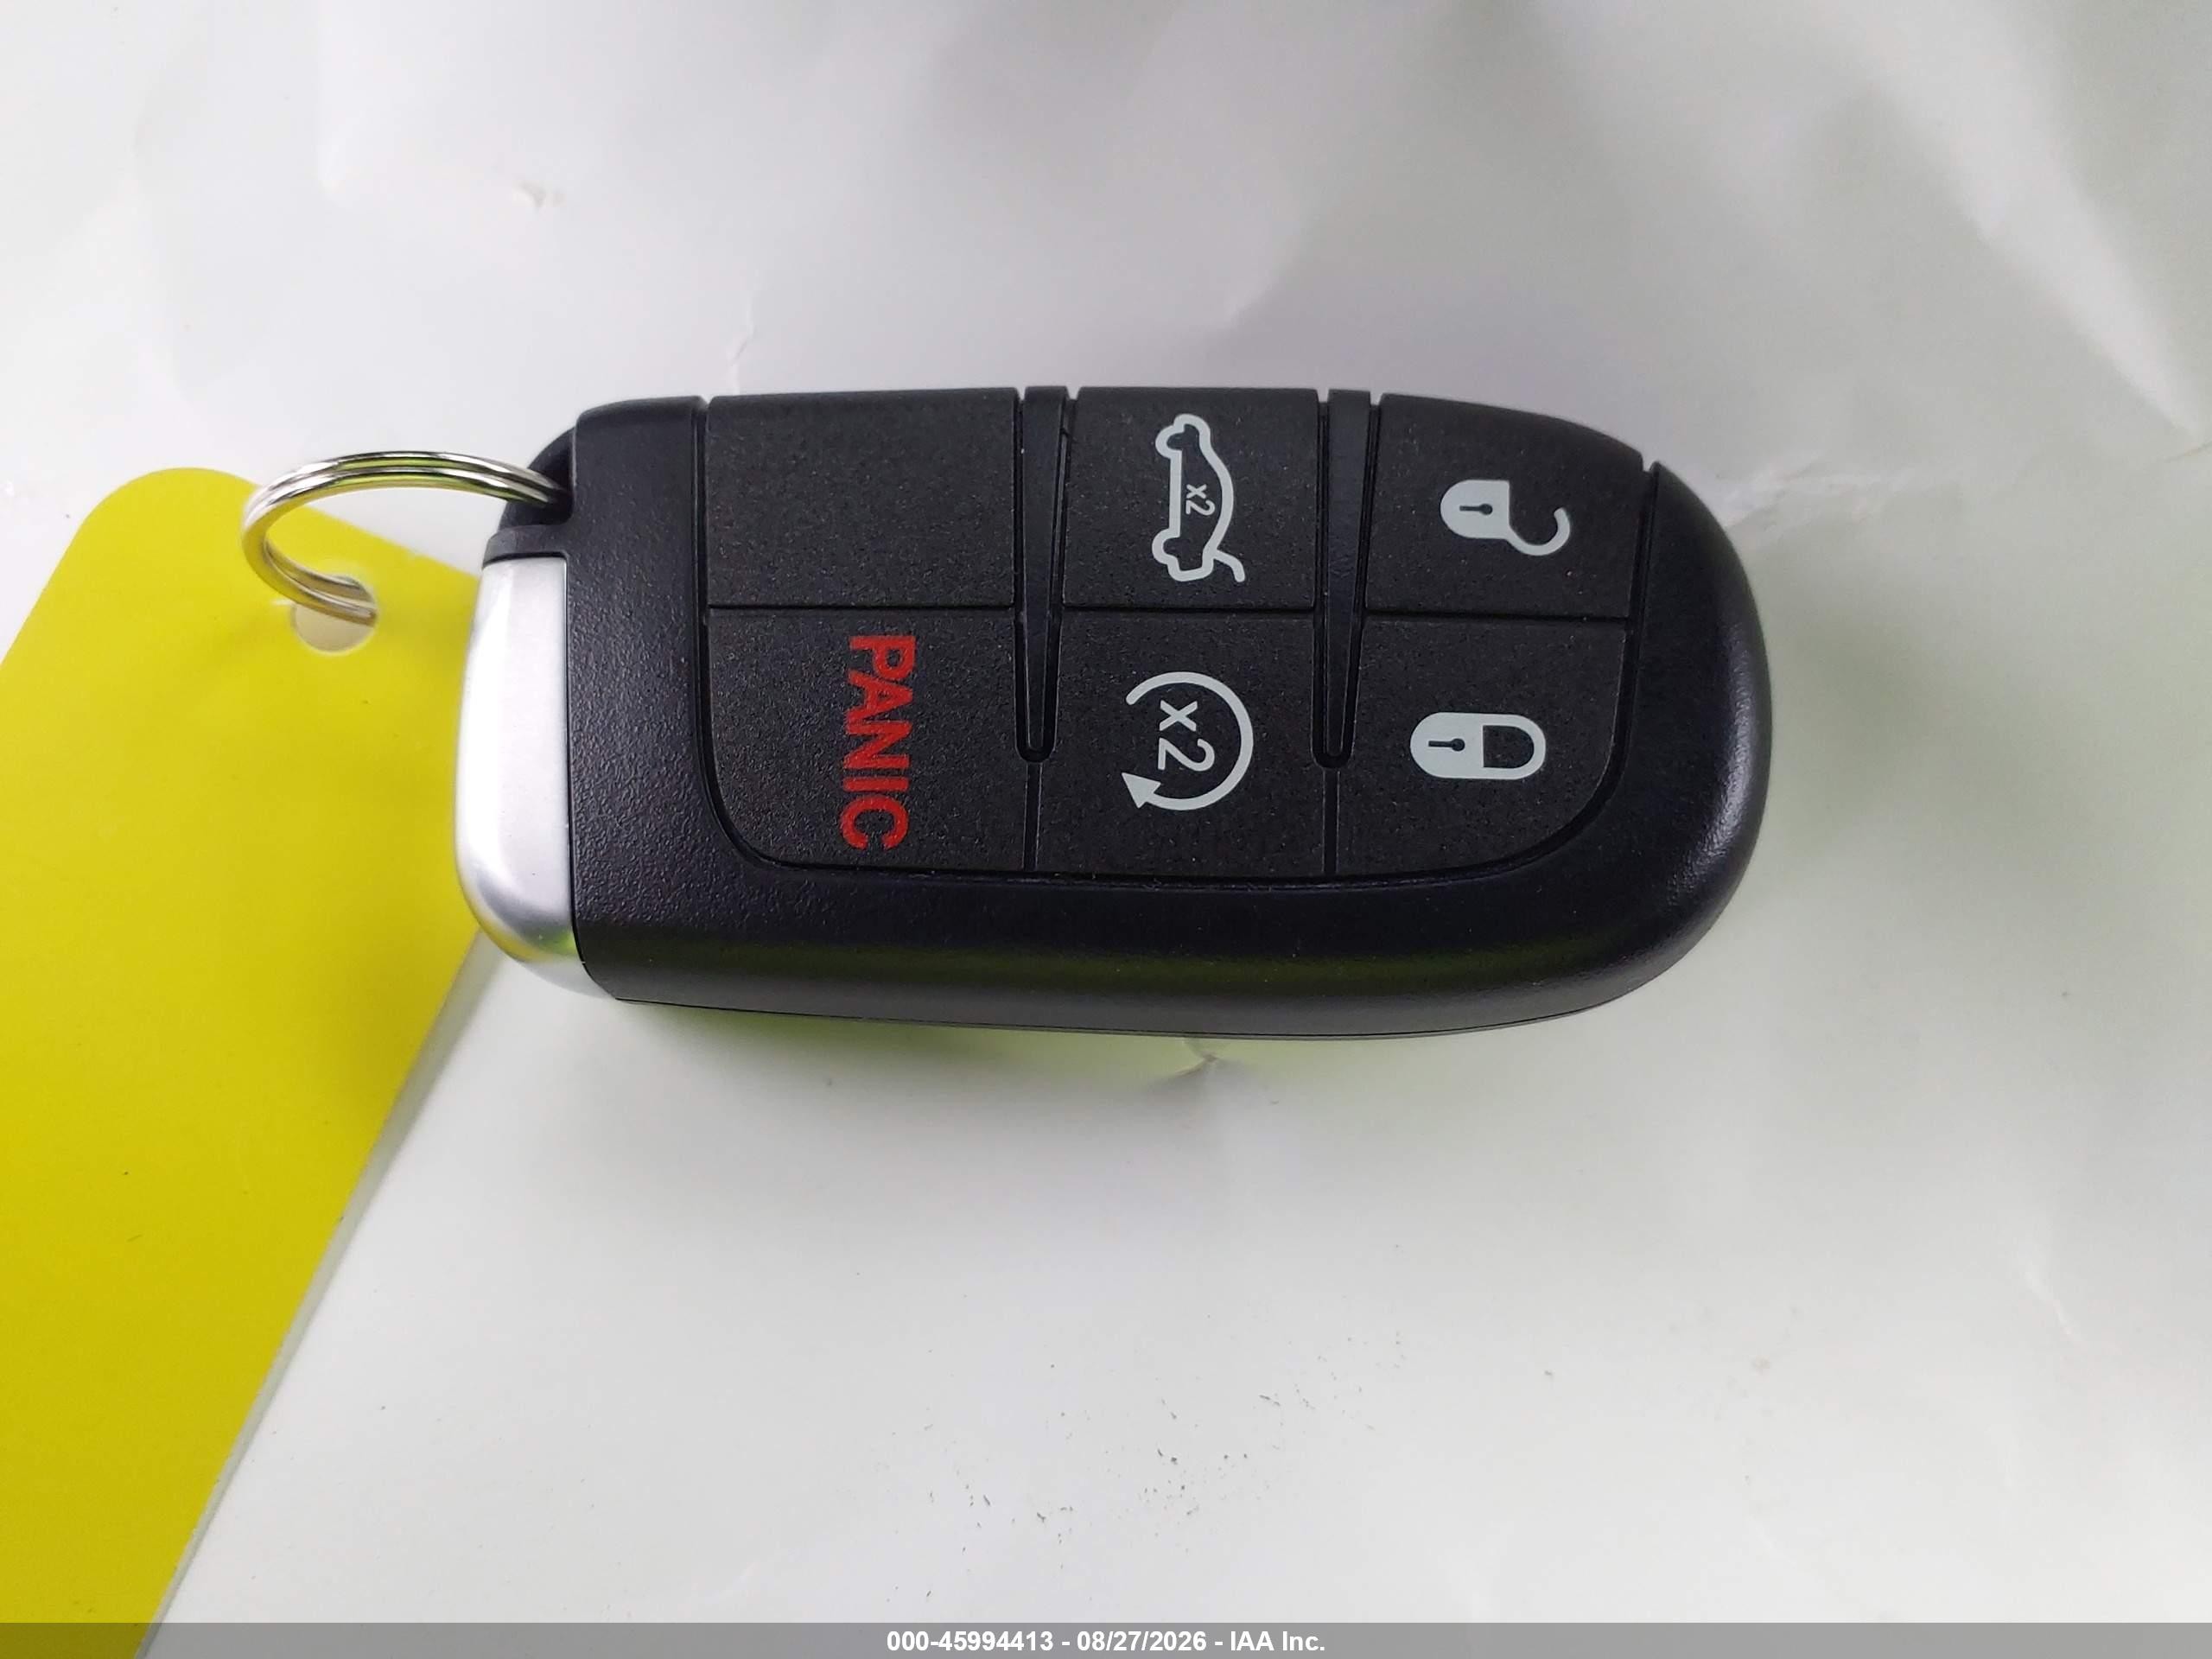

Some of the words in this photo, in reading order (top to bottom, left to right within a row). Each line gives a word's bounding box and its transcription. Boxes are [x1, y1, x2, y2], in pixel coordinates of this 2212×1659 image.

[1185, 483, 1216, 517] x2
[840, 635, 917, 850] PANIC
[1157, 700, 1216, 772] x2
